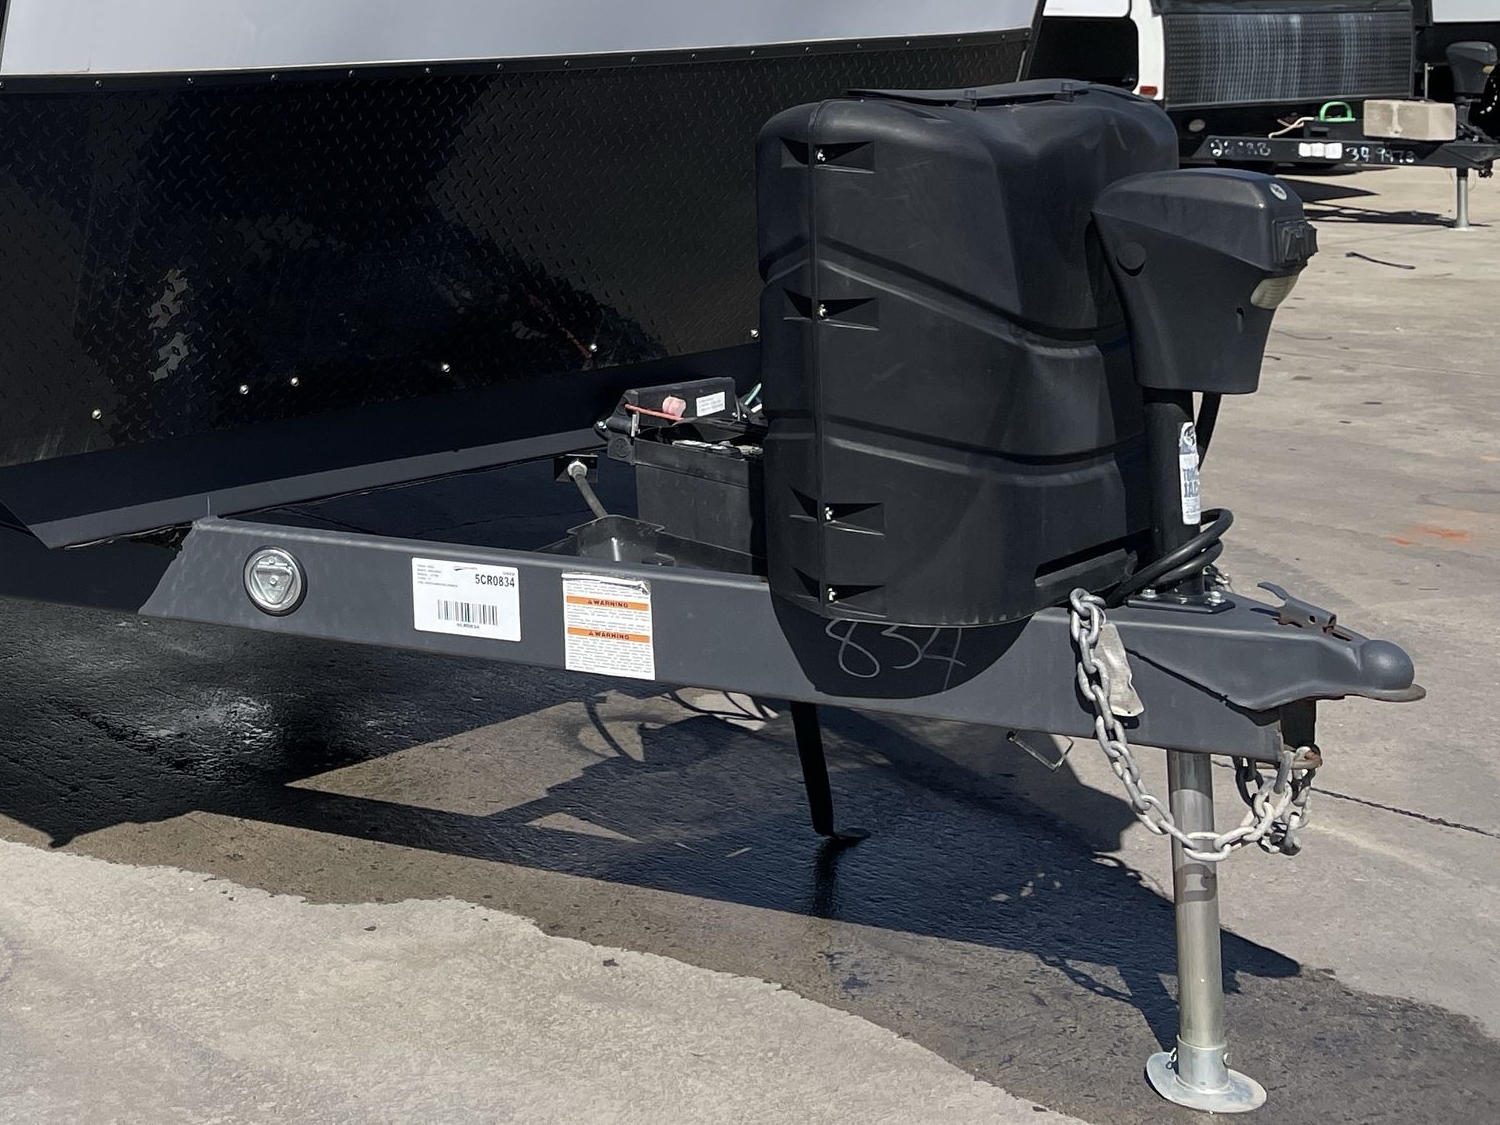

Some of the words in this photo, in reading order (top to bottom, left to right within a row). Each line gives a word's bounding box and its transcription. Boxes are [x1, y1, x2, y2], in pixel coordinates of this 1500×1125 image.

[475, 573, 515, 588] 5CR0834
[593, 598, 629, 609] WARNING
[594, 630, 630, 641] WARNING
